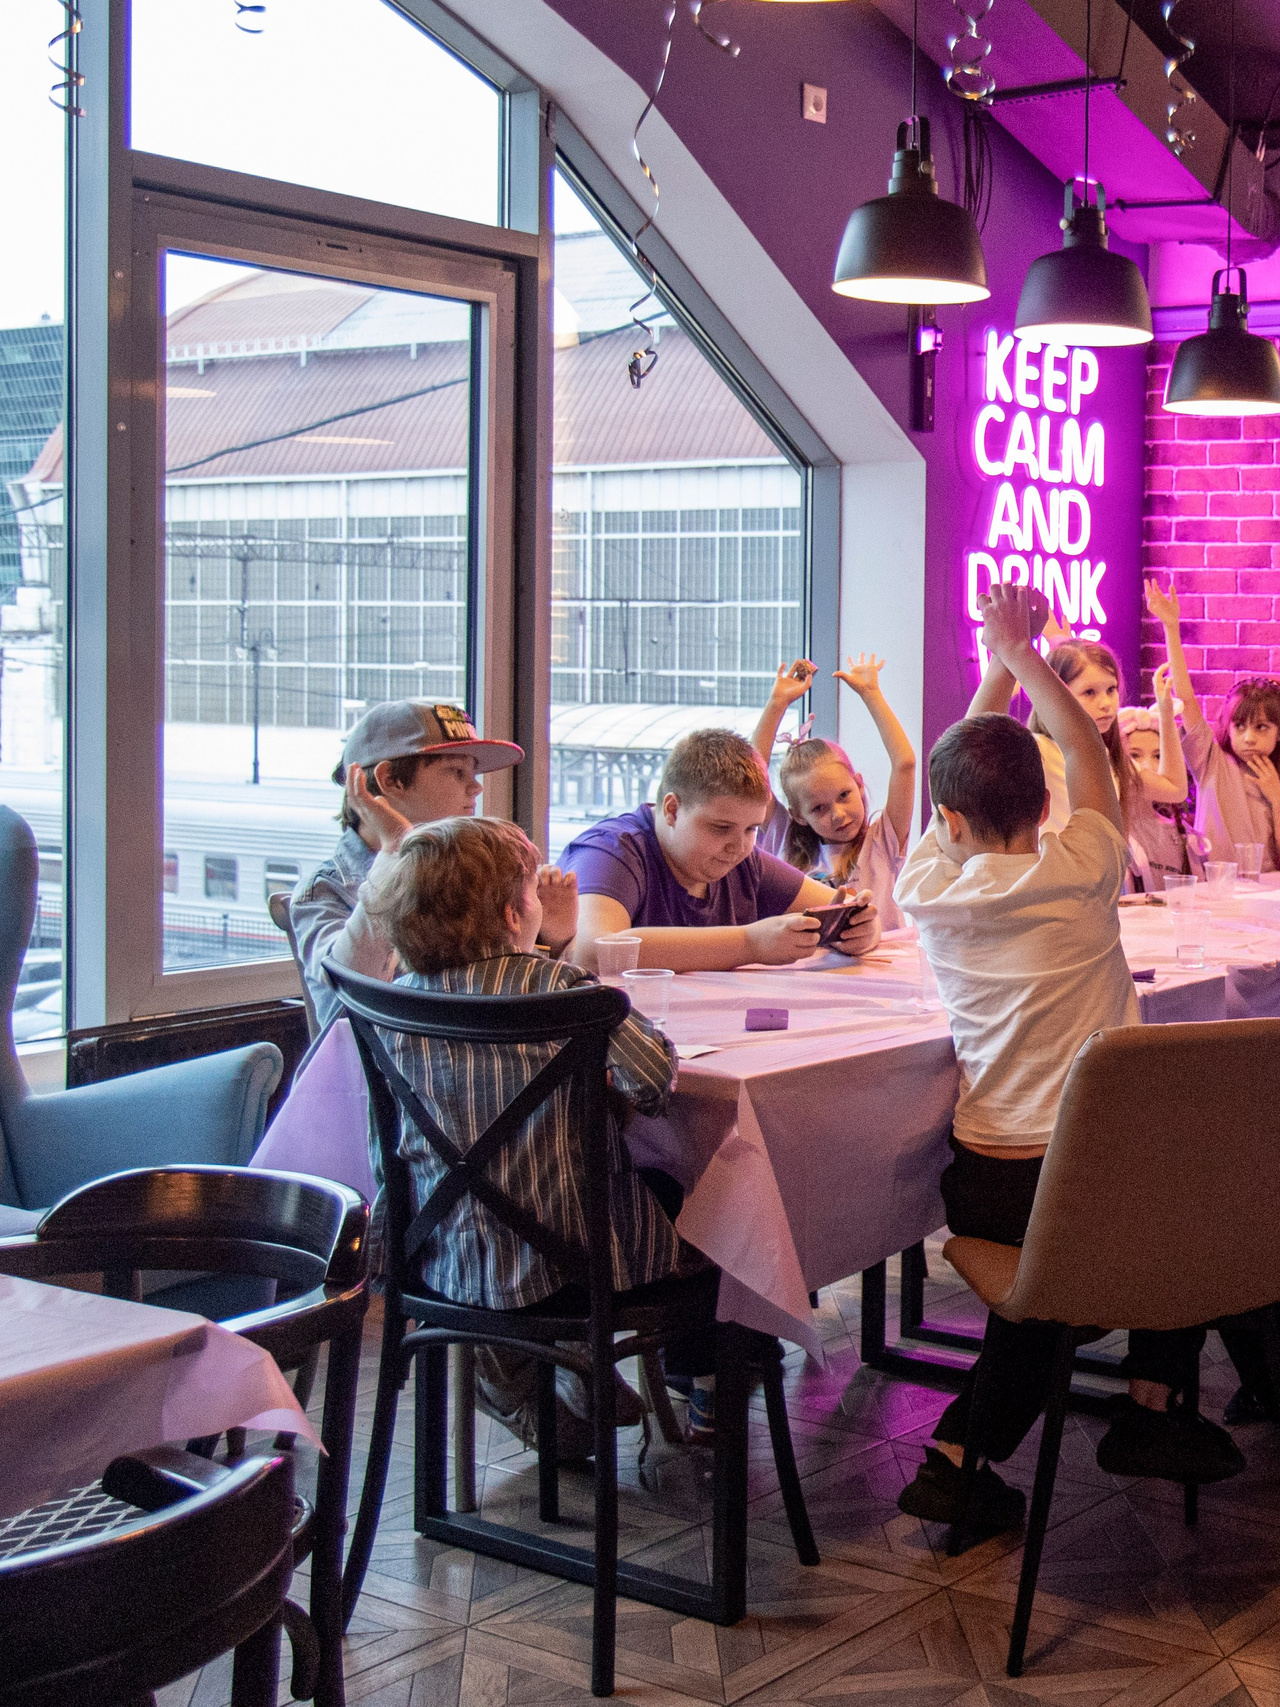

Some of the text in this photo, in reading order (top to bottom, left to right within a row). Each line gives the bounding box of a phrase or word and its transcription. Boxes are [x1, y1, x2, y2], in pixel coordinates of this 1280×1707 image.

[984, 329, 1100, 416] KEEP
[974, 404, 1105, 488] CALM
[988, 481, 1092, 556] AND
